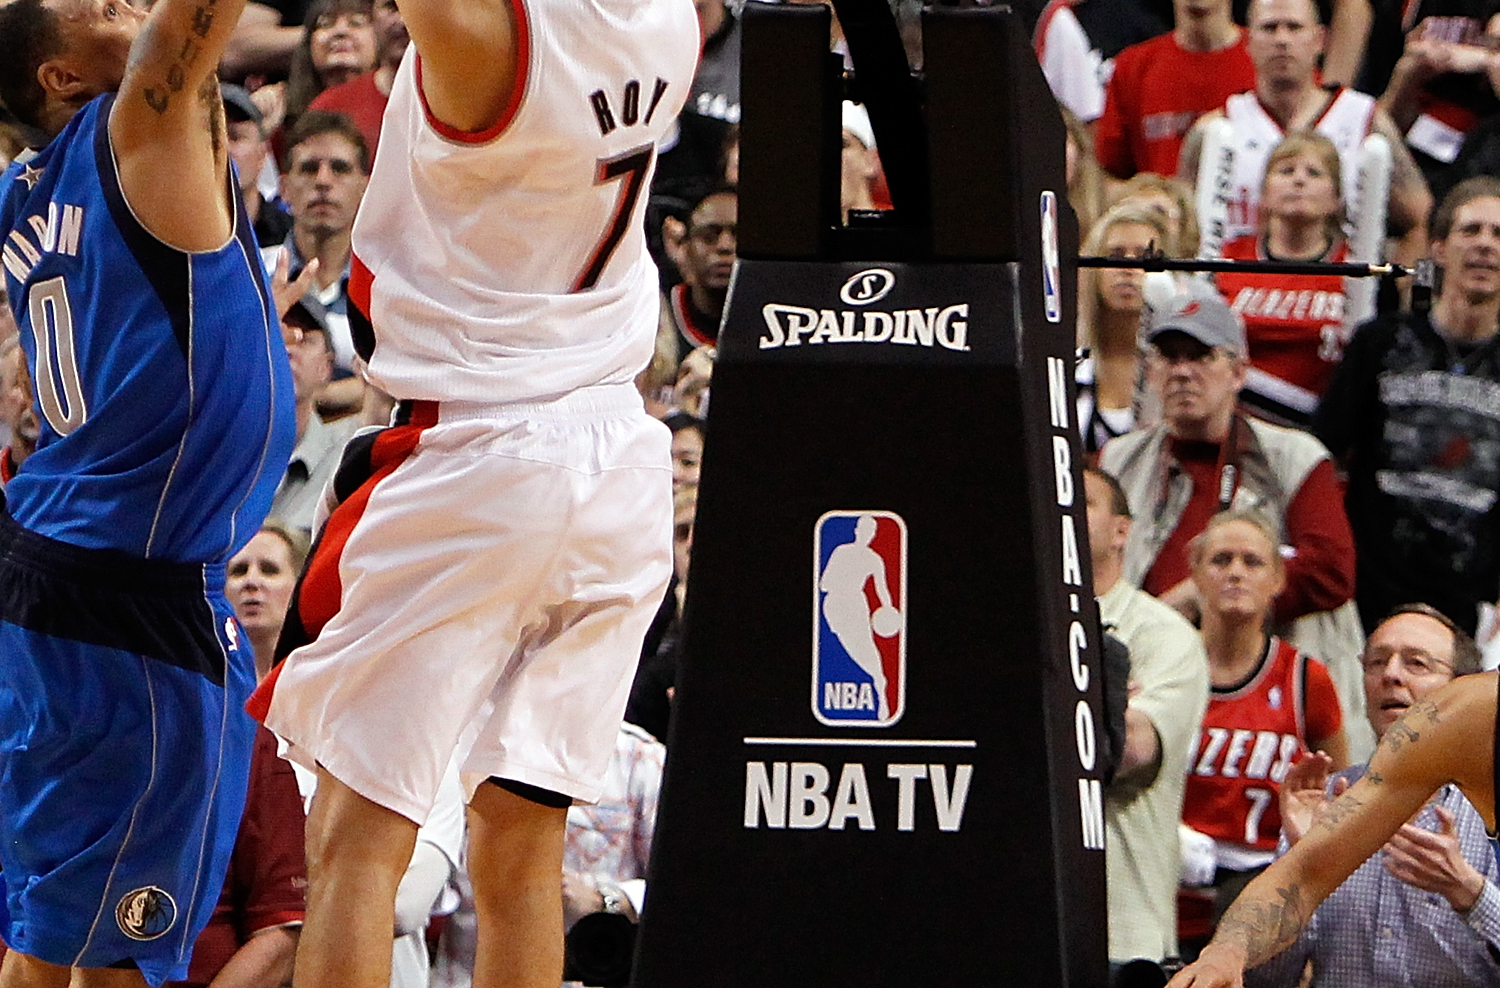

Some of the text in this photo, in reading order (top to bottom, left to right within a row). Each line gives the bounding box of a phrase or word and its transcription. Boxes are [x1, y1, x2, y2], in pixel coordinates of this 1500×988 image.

[588, 76, 669, 136] ROY
[568, 141, 655, 294] 7
[759, 303, 972, 351] SPALDING
[824, 682, 875, 711] NBA
[1187, 727, 1298, 783] ZERS
[744, 761, 974, 832] NBA TV
[1244, 787, 1272, 844] 7
